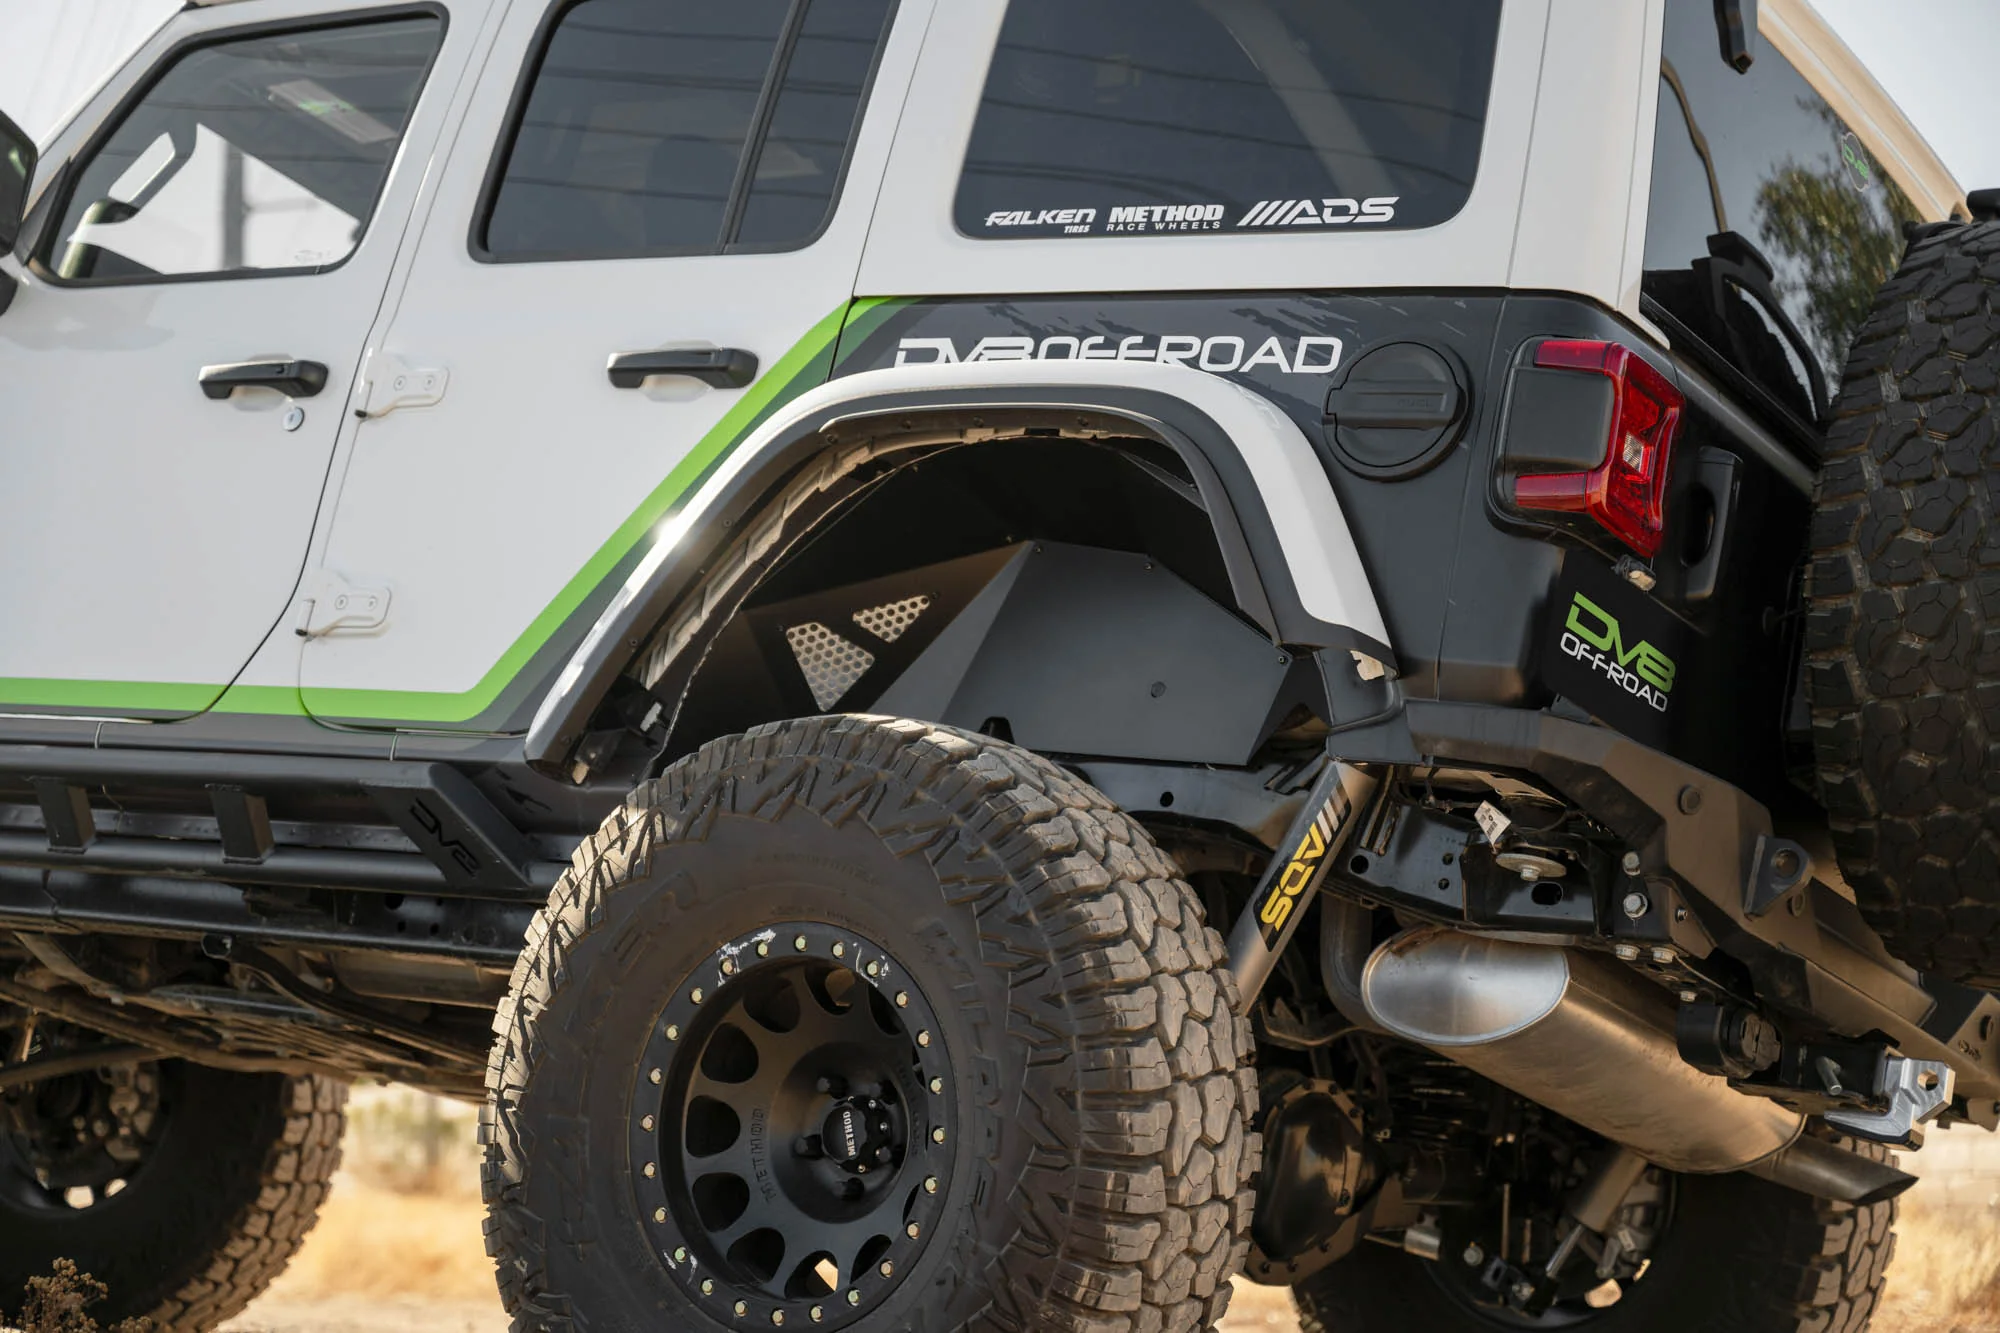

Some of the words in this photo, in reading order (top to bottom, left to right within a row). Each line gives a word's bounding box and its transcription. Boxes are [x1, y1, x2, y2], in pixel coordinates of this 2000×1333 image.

[984, 208, 1097, 227] FALKEN
[1108, 204, 1225, 222] METHOD
[1063, 224, 1091, 234] TIRES
[1106, 222, 1147, 232] RACE
[1154, 220, 1222, 231] WHEELS
[1564, 591, 1676, 693] DV8
[842, 1110, 857, 1158] METHOD
[749, 1107, 777, 1203] METHOD
